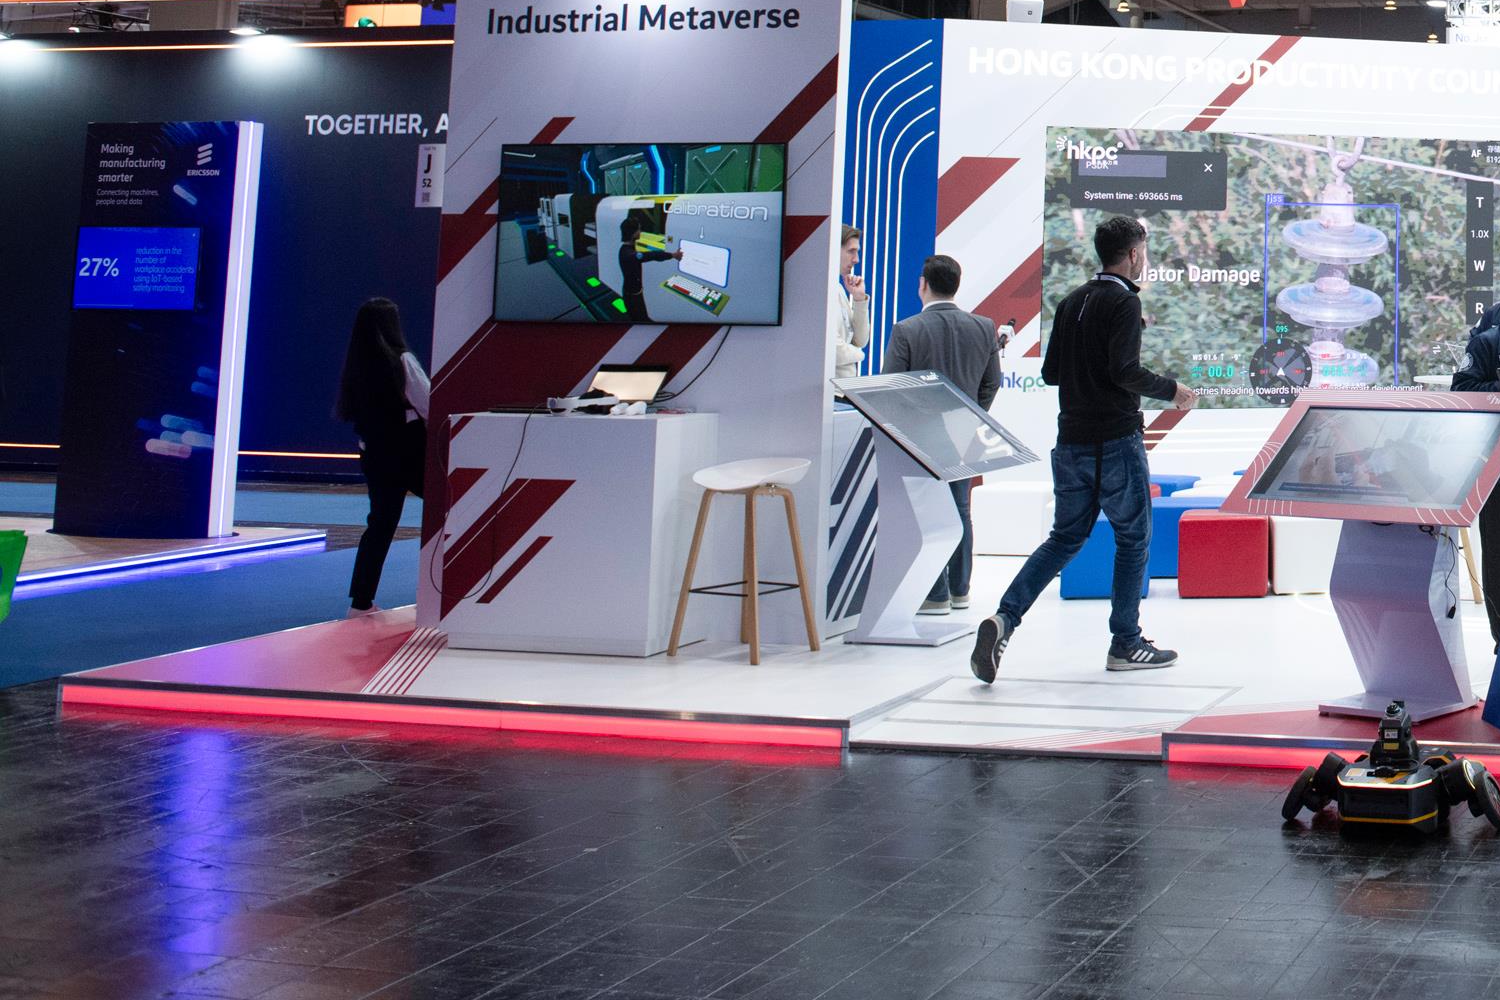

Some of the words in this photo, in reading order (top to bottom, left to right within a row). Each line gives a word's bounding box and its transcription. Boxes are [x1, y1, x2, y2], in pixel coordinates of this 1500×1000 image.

[487, 4, 628, 34] Industrial
[639, 3, 800, 31] Metaverse
[968, 47, 1072, 77] HONG
[1081, 51, 1177, 81] KONG
[1185, 56, 1420, 91] PRODUCTIVITY
[305, 113, 428, 137] TOGETHER,
[100, 143, 134, 155] Making
[1067, 140, 1118, 164] hkpc
[1471, 149, 1482, 158] AF
[99, 158, 166, 170] manufacturing
[423, 153, 432, 174] J
[98, 172, 133, 182] smarter
[422, 178, 432, 188] 52
[1084, 191, 1114, 201] System
[1115, 191, 1134, 200] time
[1139, 191, 1169, 201] 693665
[1475, 197, 1484, 208] T
[663, 200, 769, 221] Calibration
[1471, 230, 1489, 239] 1.0X
[79, 257, 120, 277] 27%
[1474, 260, 1486, 271] W
[1188, 266, 1261, 286] Damage
[1475, 303, 1484, 314] R
[1220, 386, 1253, 397] heading
[1256, 385, 1289, 395] towards
